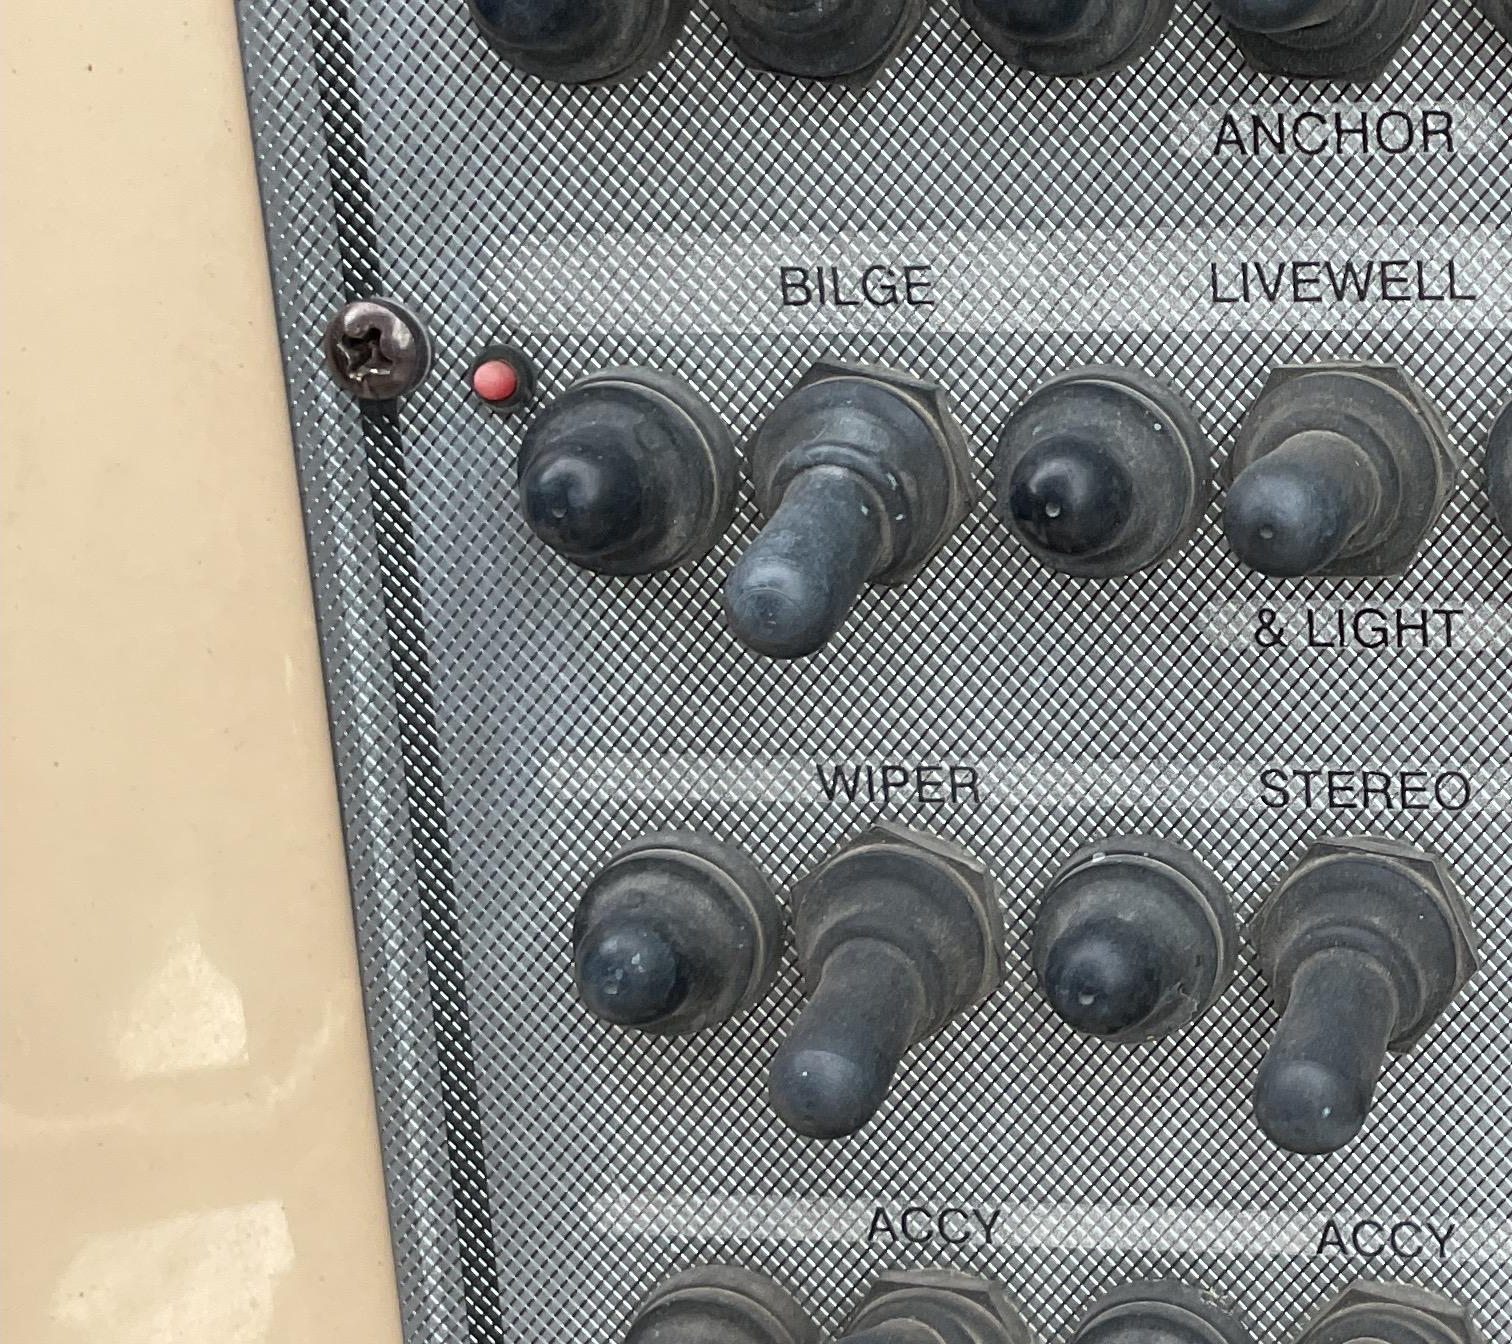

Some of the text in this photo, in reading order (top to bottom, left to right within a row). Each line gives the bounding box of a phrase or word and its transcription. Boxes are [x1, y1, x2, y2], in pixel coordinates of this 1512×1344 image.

[1213, 109, 1457, 157] ANCHOR
[780, 264, 935, 309] BILGE
[1209, 260, 1476, 304] LIVEWELL
[1256, 608, 1465, 648] & LIGHT
[816, 764, 980, 805] WIPER
[1260, 770, 1471, 812] STEREO
[867, 1207, 1002, 1248] ACCY
[1317, 1221, 1456, 1259] ACCY
